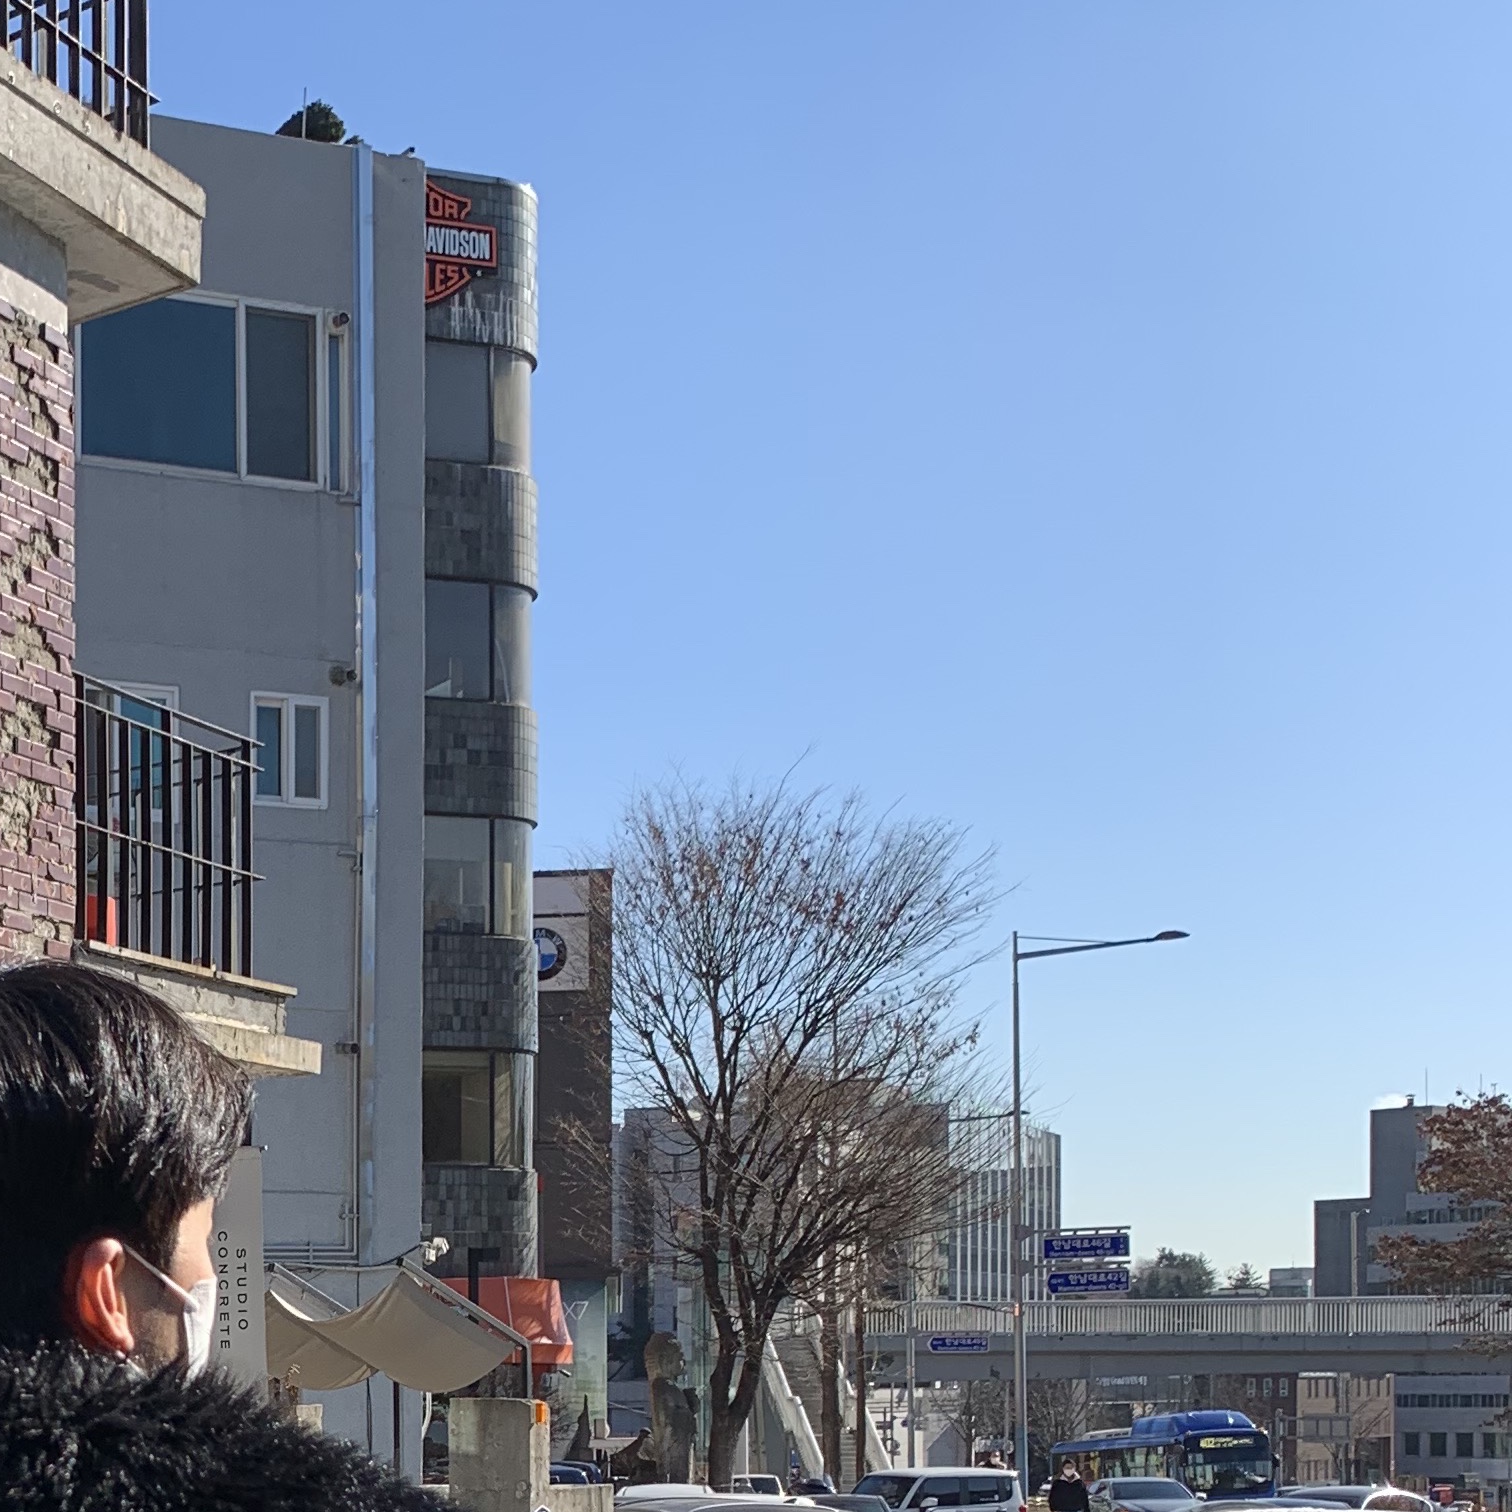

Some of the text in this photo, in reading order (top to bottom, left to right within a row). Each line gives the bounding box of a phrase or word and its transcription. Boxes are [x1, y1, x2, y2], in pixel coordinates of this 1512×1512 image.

[428, 191, 458, 219] OR
[427, 226, 491, 260] AVIDSON
[217, 1230, 231, 1349] CONCRETE
[236, 1248, 249, 1331] STUDIO
